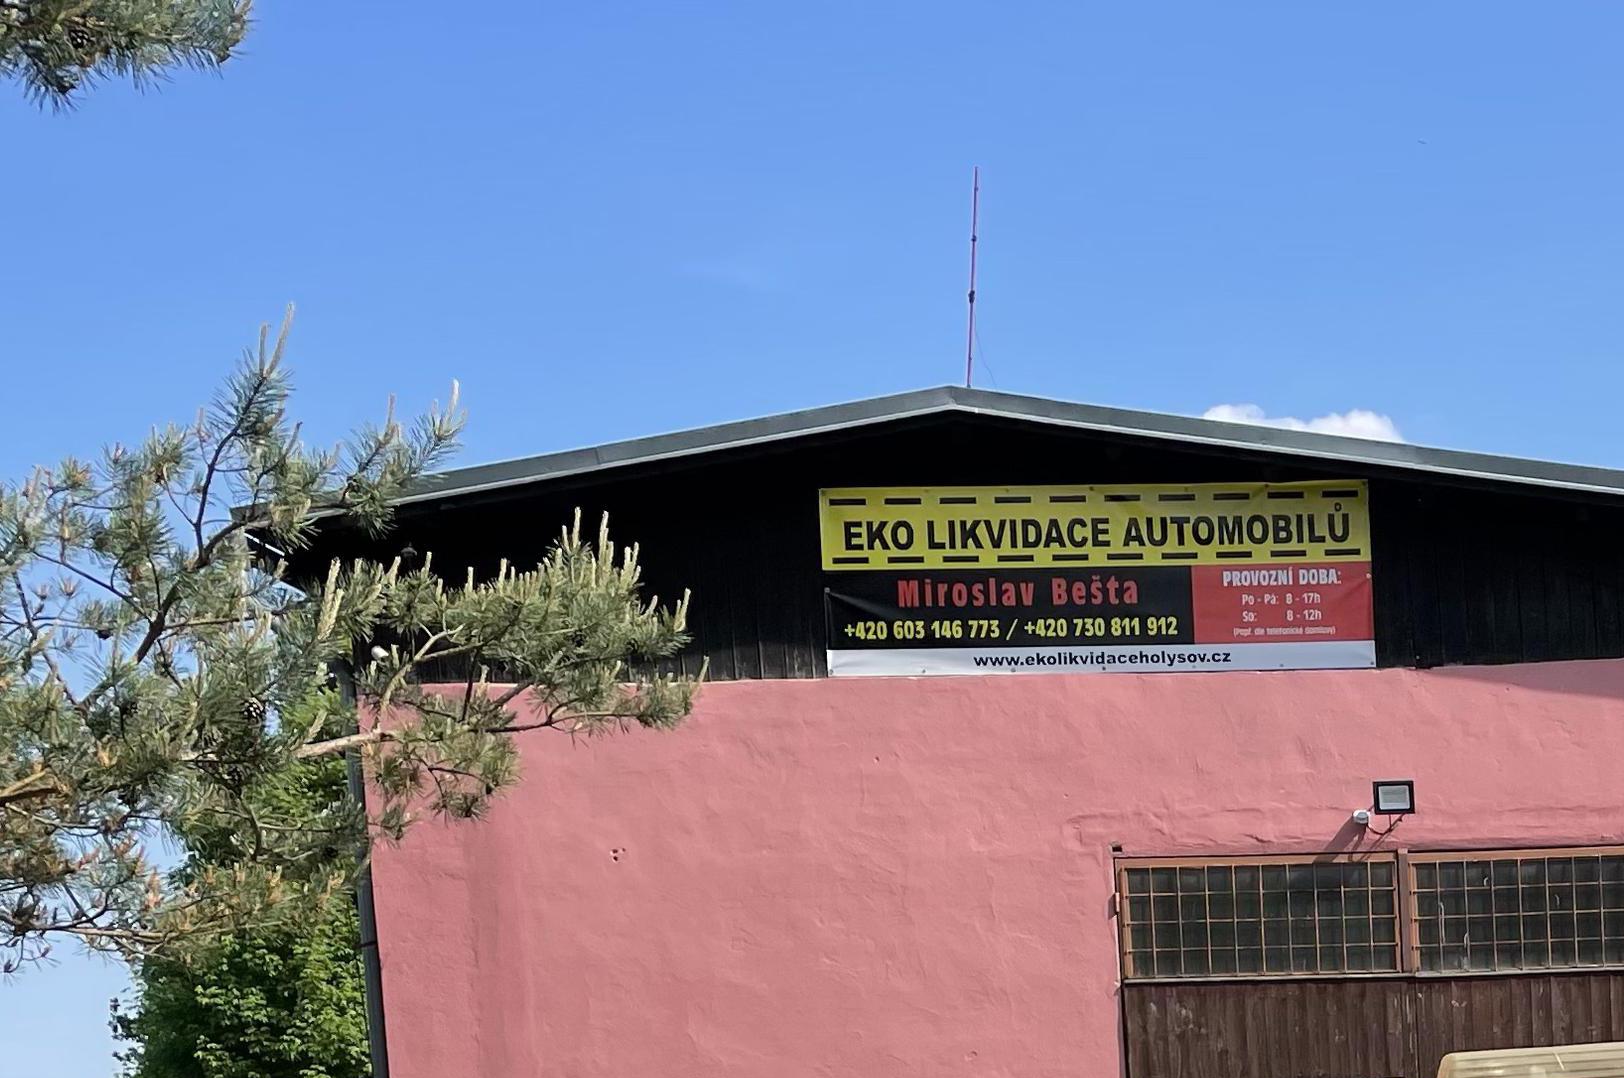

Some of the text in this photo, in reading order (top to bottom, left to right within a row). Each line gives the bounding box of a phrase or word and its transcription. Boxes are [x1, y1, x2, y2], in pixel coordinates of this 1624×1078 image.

[843, 502, 1350, 552] EKO LIKVIDACE AUTOMOBILŮ
[1222, 566, 1342, 587] PROVOZNÍ DOBA:
[897, 574, 1140, 608] Miroslav Bešta
[1241, 593, 1255, 606] Po
[1285, 592, 1294, 605] 8
[1302, 592, 1321, 604] 17h
[1242, 610, 1258, 623] So:
[1286, 609, 1294, 621] 8
[1303, 609, 1322, 621] 12h
[843, 616, 1179, 641] +420 603 146 773 / +420 730 811 912
[973, 650, 1232, 667] www.ekolikvidaceholysov.cz
